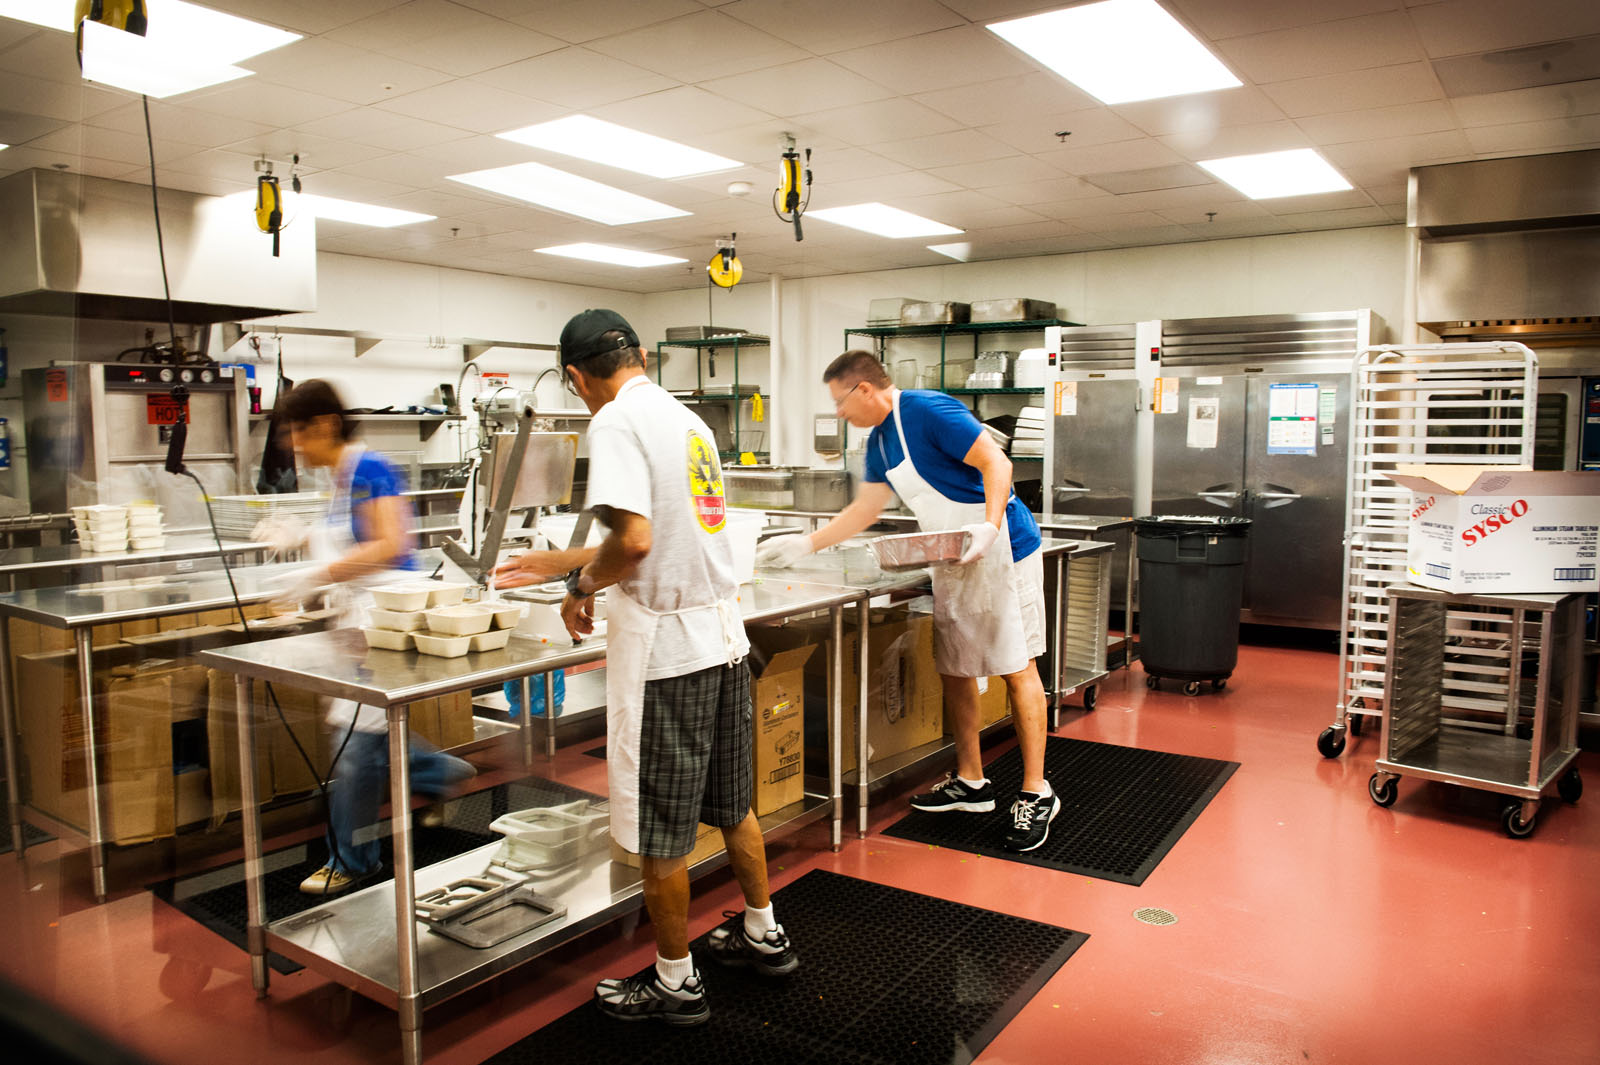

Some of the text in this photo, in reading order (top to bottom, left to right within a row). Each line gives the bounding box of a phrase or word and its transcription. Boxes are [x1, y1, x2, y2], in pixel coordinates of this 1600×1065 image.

[155, 407, 184, 421] HOT
[1471, 503, 1507, 515] Classic
[1461, 499, 1528, 547] SYSCO
